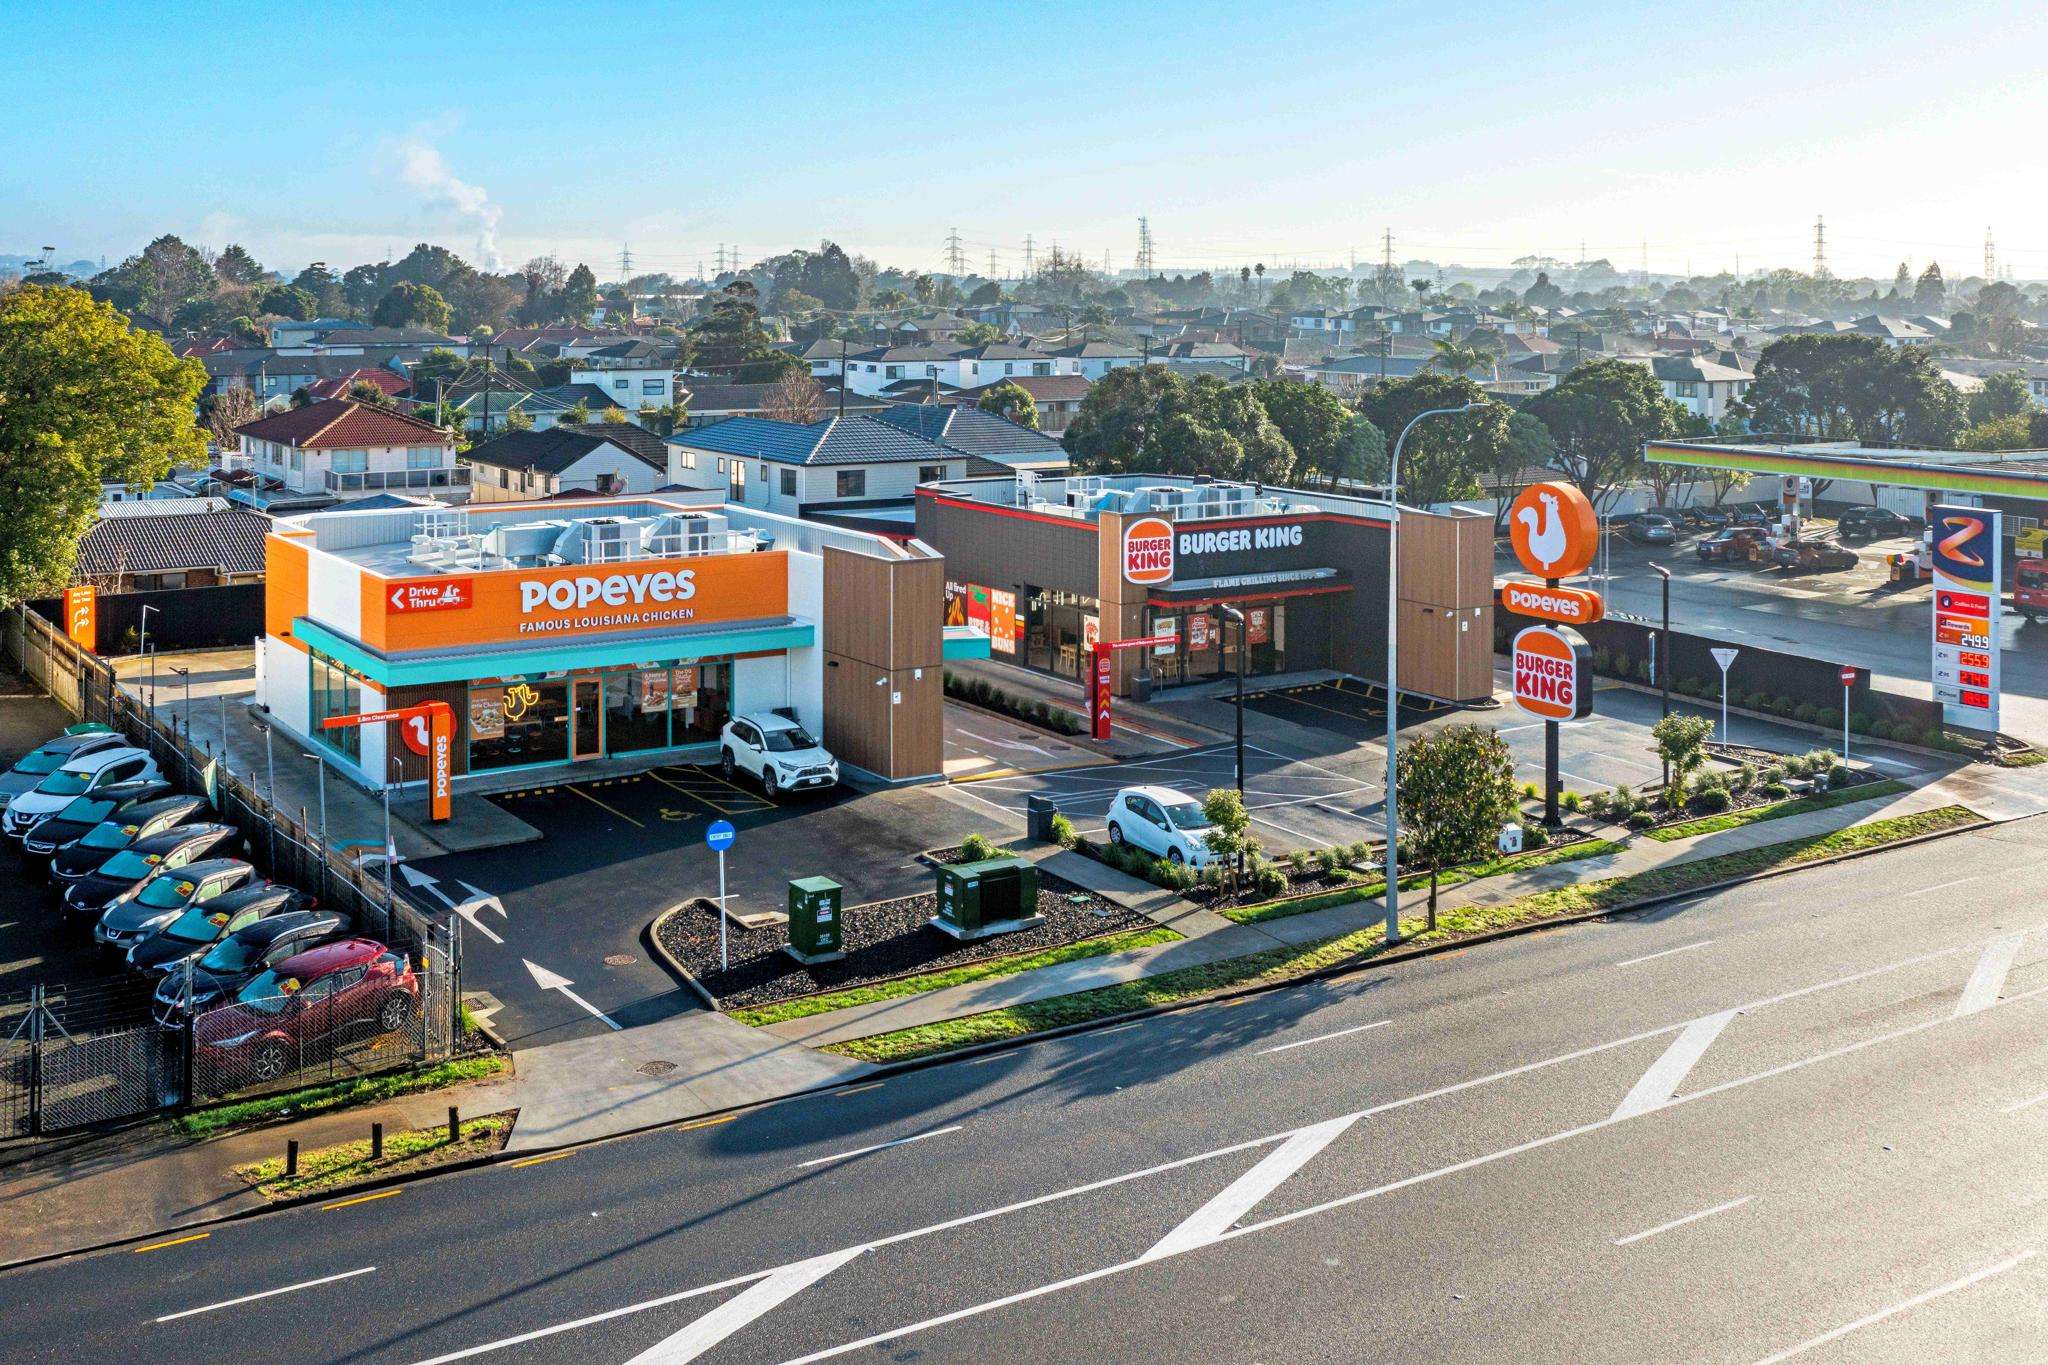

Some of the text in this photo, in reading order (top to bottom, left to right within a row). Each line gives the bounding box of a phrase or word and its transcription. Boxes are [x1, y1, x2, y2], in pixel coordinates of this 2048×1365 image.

[1128, 538, 1171, 552] BURGER
[1179, 525, 1303, 555] BURGER KING
[1128, 551, 1171, 570] KING
[1213, 577, 1241, 588] FLAME
[1241, 574, 1277, 586] GRILLING
[1277, 572, 1300, 582] SINCE
[408, 585, 439, 598] Drive
[945, 590, 954, 601] Up
[409, 597, 437, 609] Thru
[519, 608, 694, 633] FAMOUS LOUISIANA CHICKEN
[1961, 633, 1989, 649] 249.9
[1515, 652, 1573, 681] BURGER
[1515, 670, 1573, 705] KING
